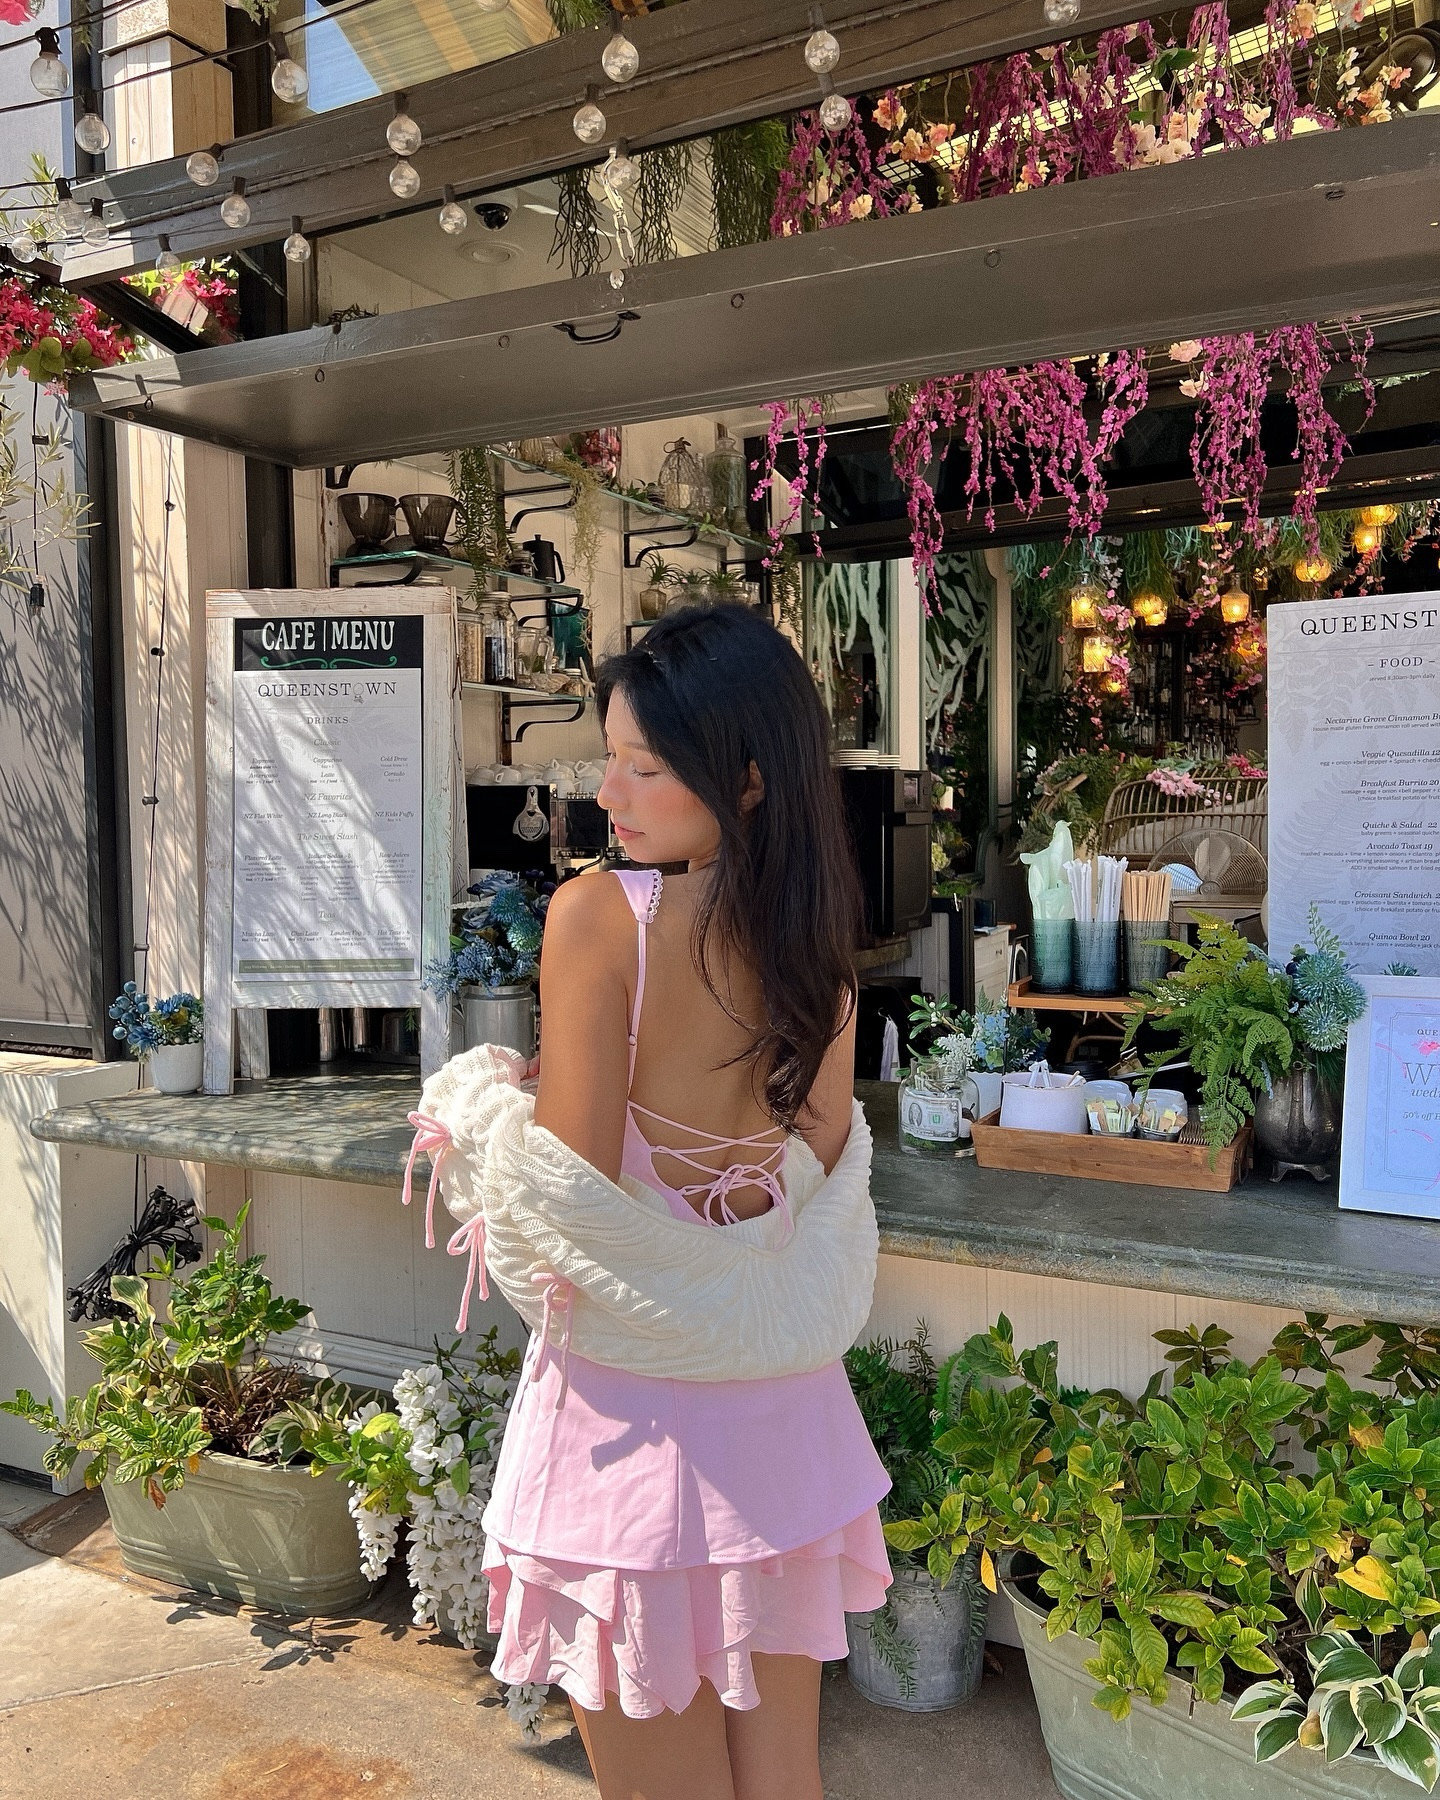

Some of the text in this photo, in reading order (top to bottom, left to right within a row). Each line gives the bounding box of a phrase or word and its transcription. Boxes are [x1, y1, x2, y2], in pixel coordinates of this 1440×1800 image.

[1301, 610, 1437, 635] QUEENST
[262, 620, 395, 650] CAFE MENU
[1380, 657, 1423, 668] FOOD
[307, 716, 349, 724] DRINKS
[1325, 716, 1361, 724] Nectarine
[1362, 751, 1385, 759] Veggie
[1387, 749, 1430, 758] Quesadilla
[1361, 780, 1397, 788] Breakfast
[303, 793, 317, 801] NZ
[1362, 821, 1390, 830] Quiche
[1393, 891, 1432, 899] Sandwich
[1368, 933, 1398, 941] Quinoa
[1403, 1062, 1440, 1085] W
